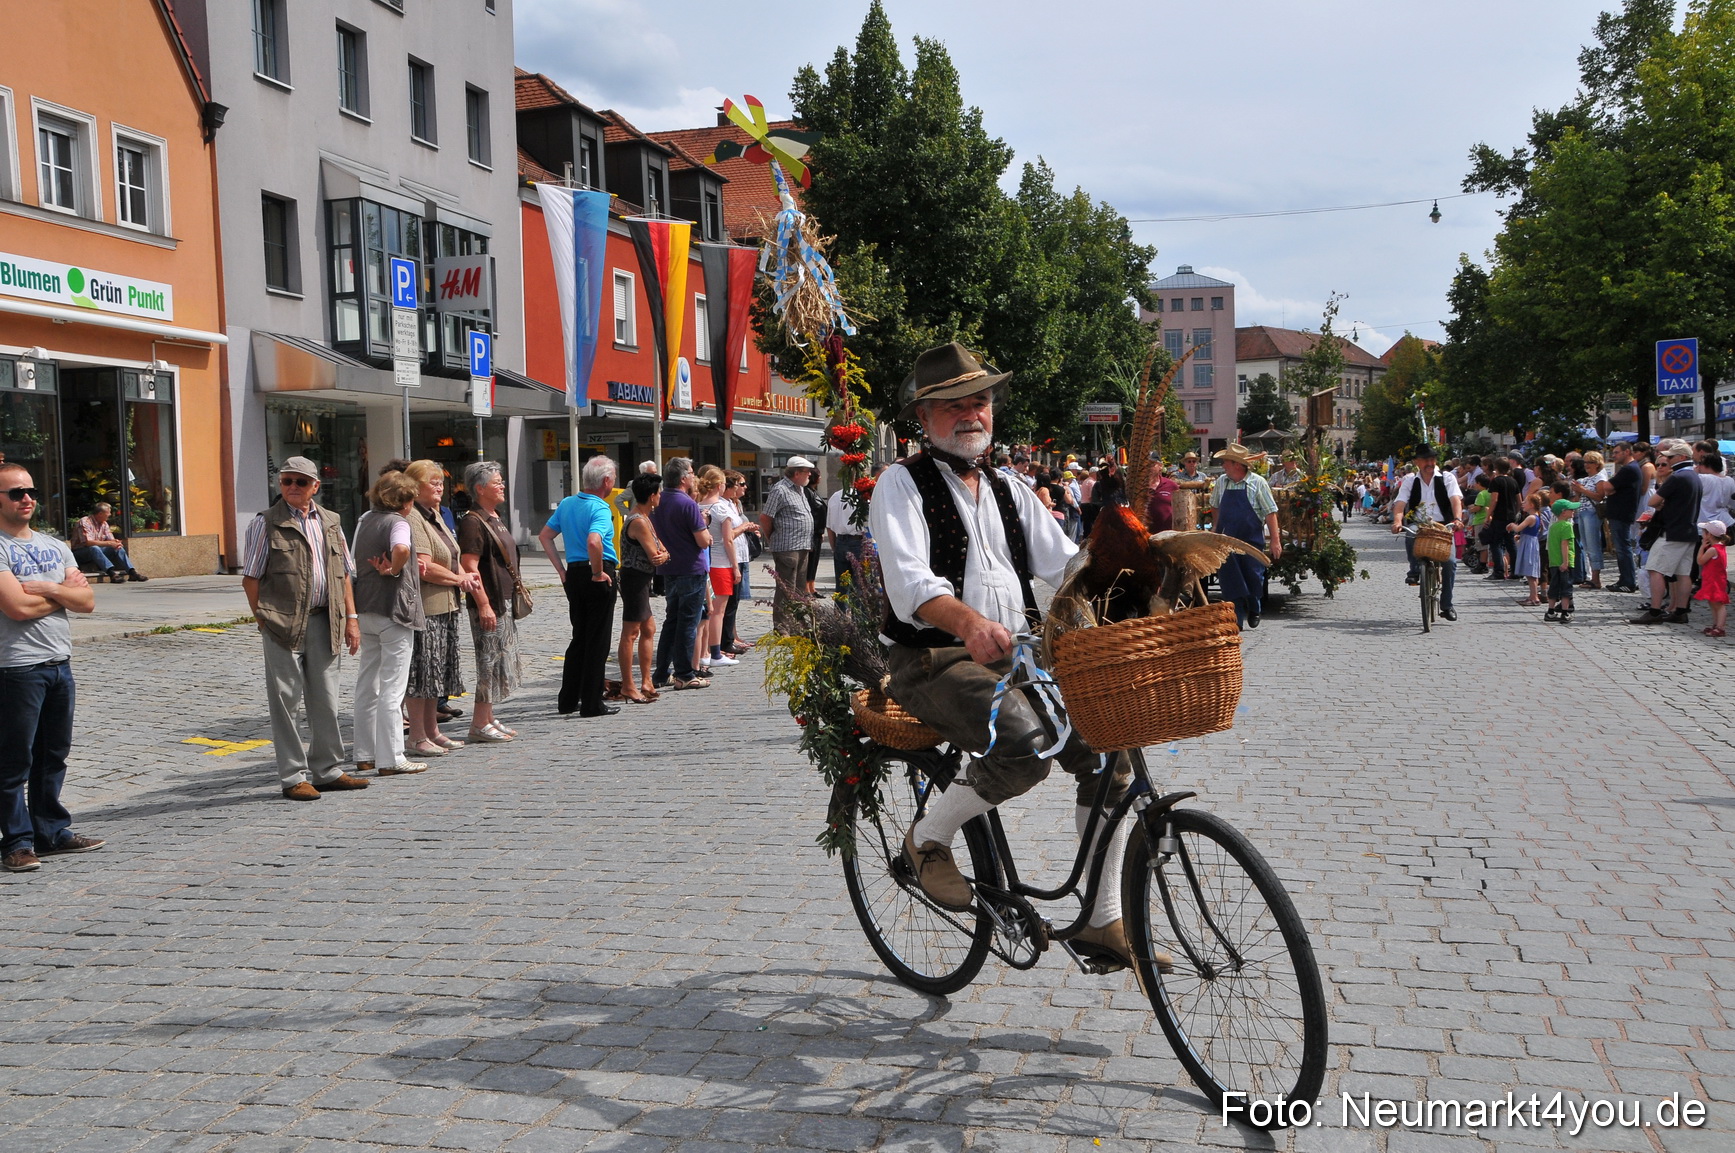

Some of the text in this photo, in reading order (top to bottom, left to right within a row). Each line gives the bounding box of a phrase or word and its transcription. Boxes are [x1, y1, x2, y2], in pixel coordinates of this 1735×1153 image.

[1, 261, 165, 312] Blumen Grün Punkt
[397, 265, 411, 301] P
[440, 266, 482, 300] H&M
[474, 338, 486, 371] P
[1661, 377, 1694, 391] TAXI
